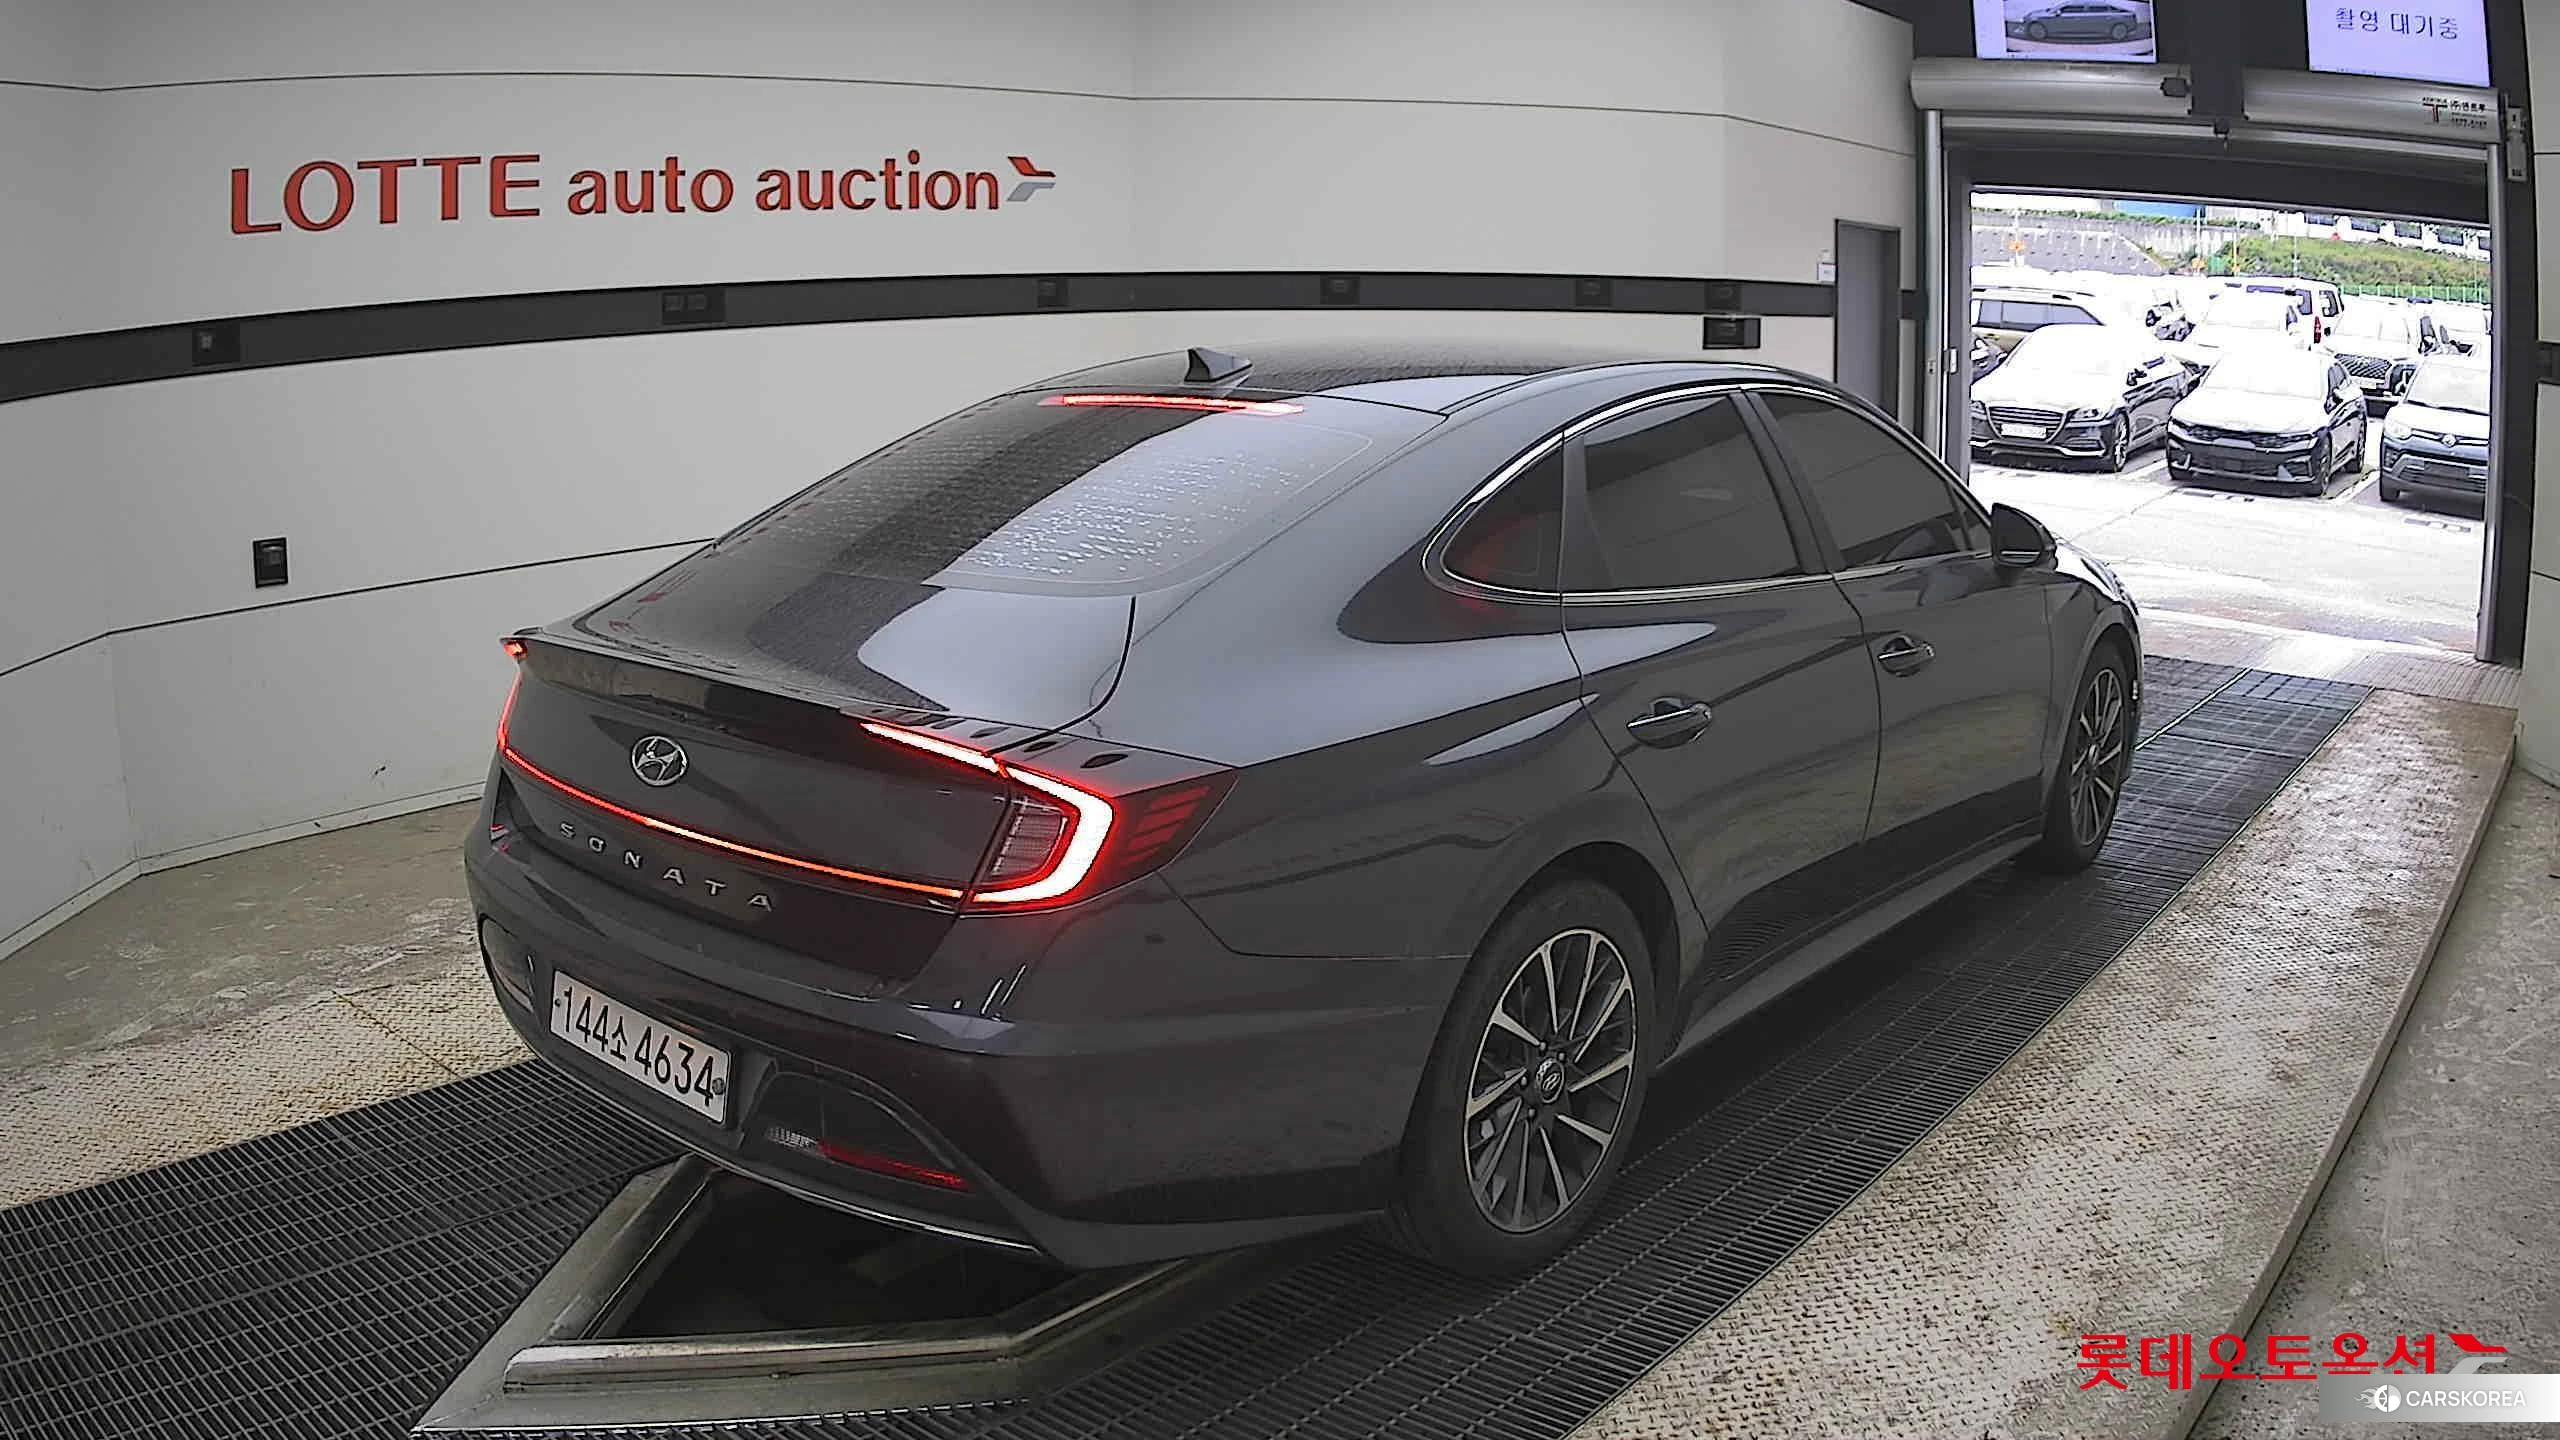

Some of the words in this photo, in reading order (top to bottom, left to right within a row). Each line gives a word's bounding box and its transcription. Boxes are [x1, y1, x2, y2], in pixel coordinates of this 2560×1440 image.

[2335, 7, 2379, 33] 촬영
[2389, 12, 2459, 41] 대기중
[232, 154, 540, 235] LOTTE
[568, 155, 735, 215] auto
[755, 150, 1000, 211] auction
[559, 822, 773, 913] SONATA
[634, 1026, 714, 1107] 4634
